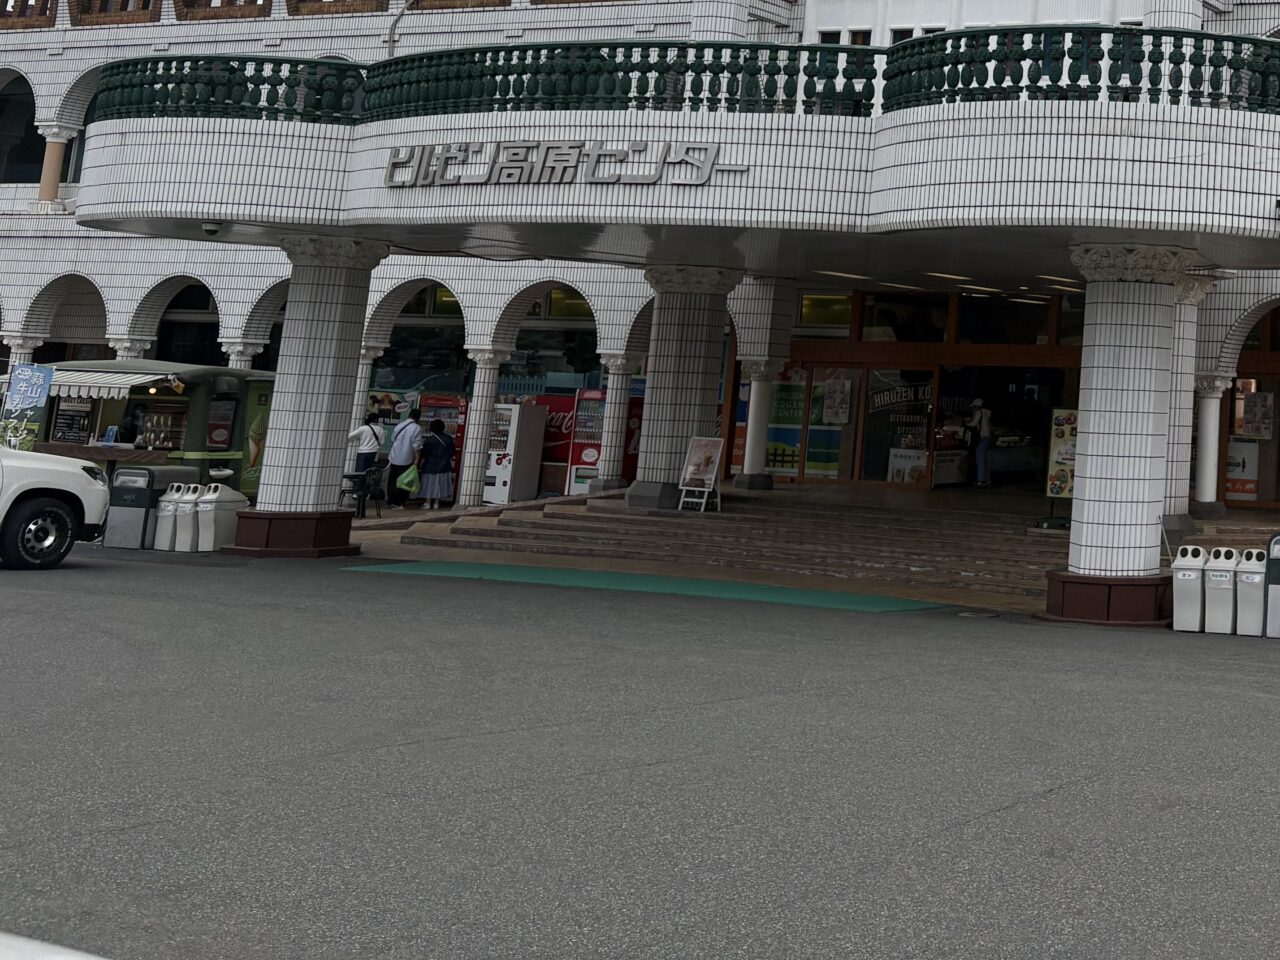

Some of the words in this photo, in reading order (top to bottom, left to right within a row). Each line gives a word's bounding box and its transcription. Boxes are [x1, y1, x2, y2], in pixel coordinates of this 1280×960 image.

[384, 140, 748, 187] ヒルゼン高原センター
[874, 387, 914, 407] HIRUZEN
